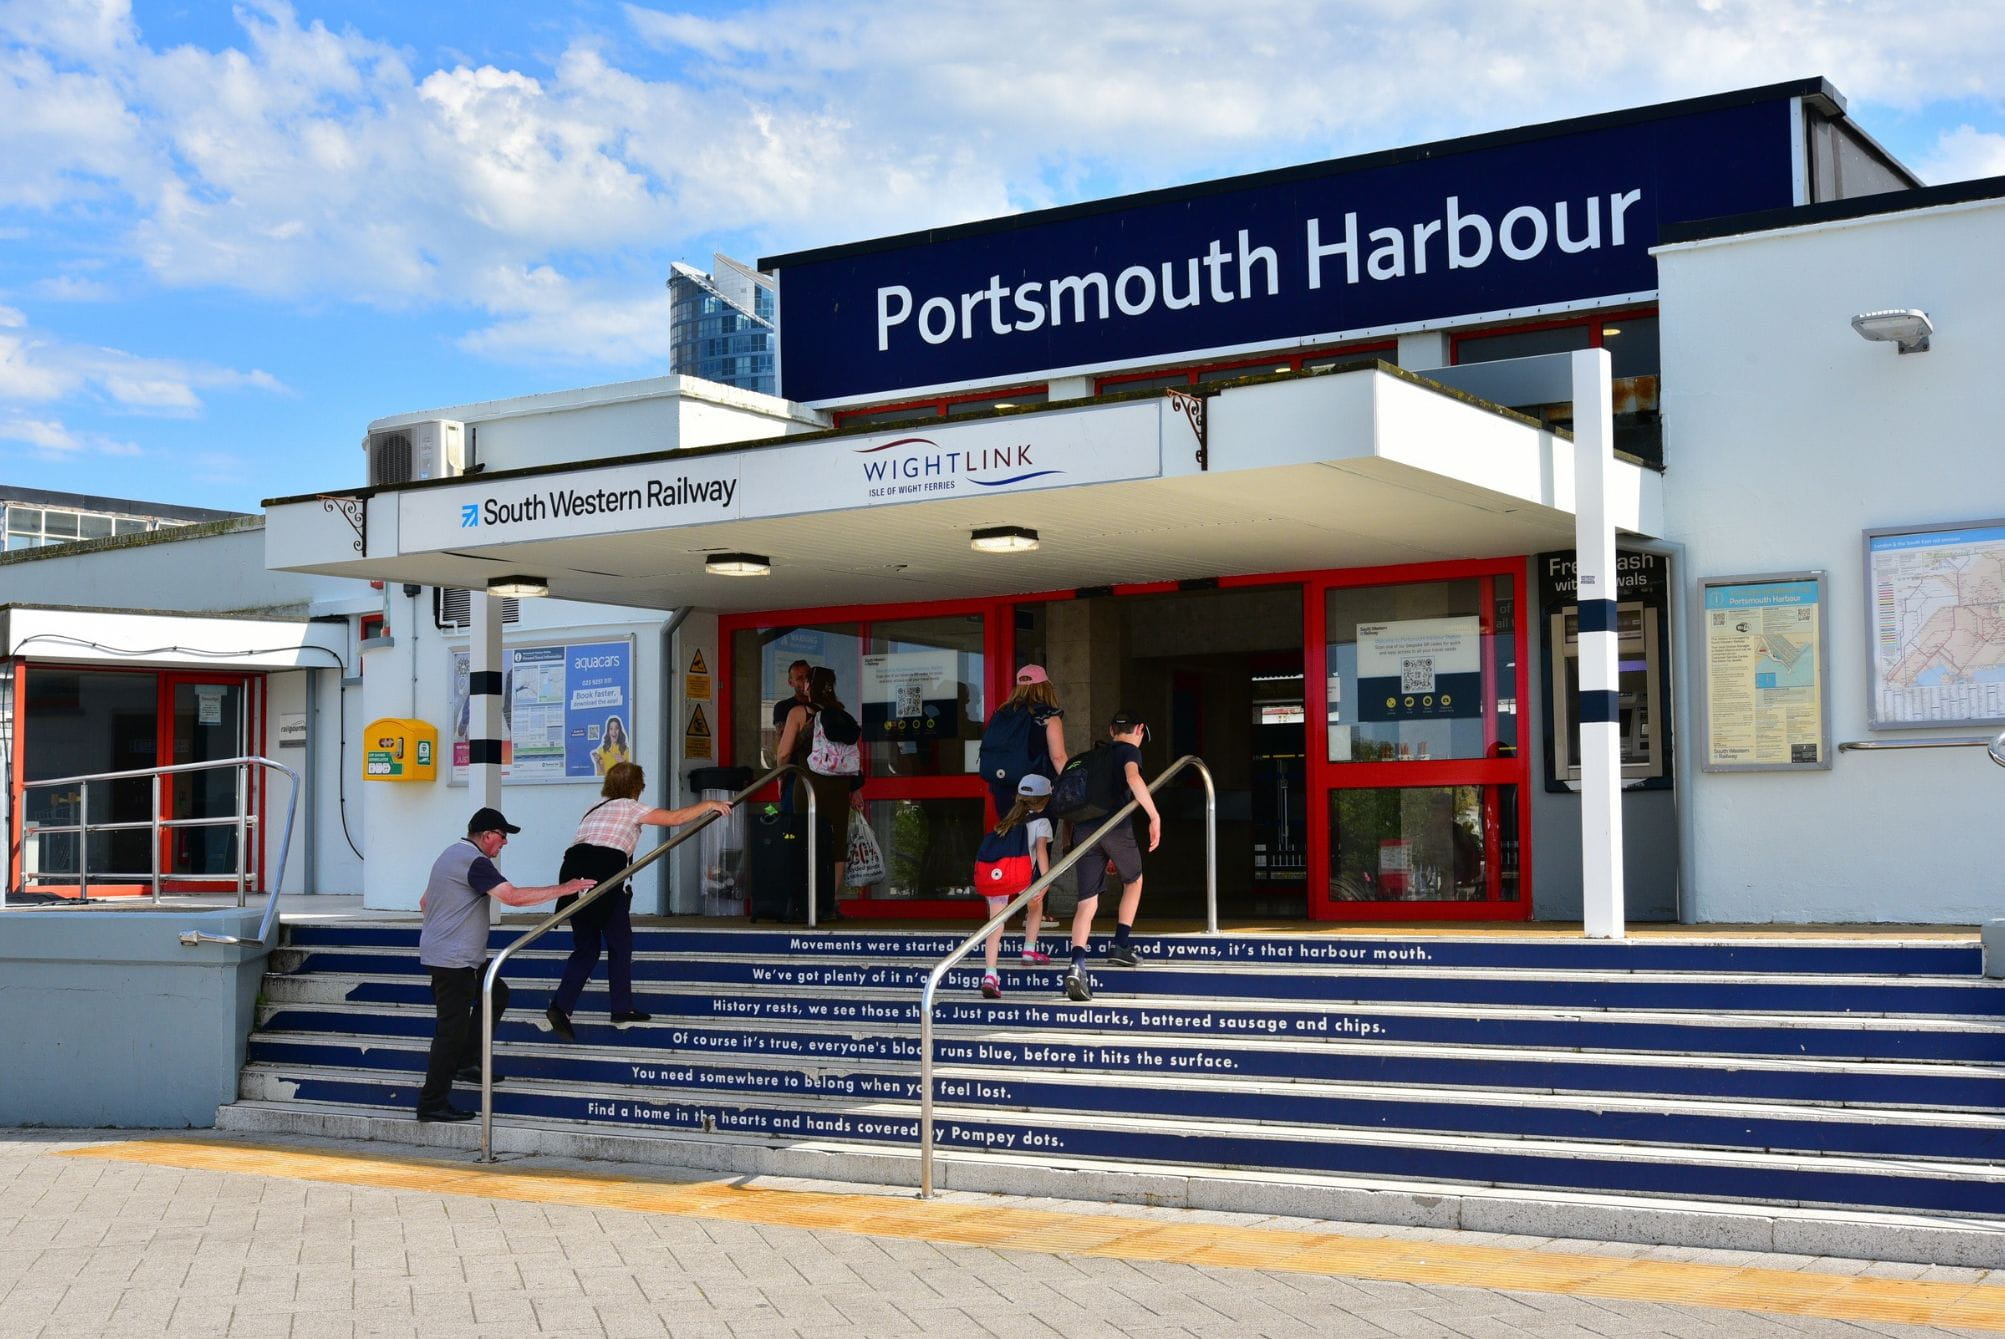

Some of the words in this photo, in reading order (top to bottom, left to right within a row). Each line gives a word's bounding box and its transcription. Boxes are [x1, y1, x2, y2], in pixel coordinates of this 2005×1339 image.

[876, 229, 1280, 351] Portsmouth
[1307, 188, 1642, 290] Harbour
[863, 444, 1033, 482] WIGHTLINK
[483, 493, 546, 526] South
[549, 488, 642, 518] Western
[647, 477, 737, 510] Railway
[869, 486, 885, 497] ISLE
[887, 486, 897, 496] OF
[899, 483, 922, 494] WIGHT
[924, 480, 956, 491] FERRIES
[1549, 557, 1577, 576] Fre
[1616, 552, 1654, 570] ash
[1555, 571, 1648, 592] witwals
[574, 655, 620, 672] aquacars
[790, 938, 862, 951] Movements
[867, 942, 900, 951] were
[905, 939, 954, 951] started
[998, 940, 1023, 952] this
[1035, 940, 1058, 956] ity,
[1065, 939, 1092, 953] lie
[1133, 941, 1161, 954] ood
[1167, 945, 1222, 958] yawns,
[1229, 943, 1254, 956] it's
[1260, 943, 1293, 957] that
[1300, 944, 1367, 959] harbour
[1373, 946, 1432, 960] mouth.
[752, 968, 792, 981] We've
[797, 971, 819, 984] got
[824, 969, 866, 985] plenty
[871, 970, 886, 983] of
[891, 971, 901, 983] it
[1007, 973, 1020, 986] in
[1026, 973, 1049, 986] the
[713, 1000, 761, 1015] History
[766, 1003, 802, 1016] rests,
[808, 1006, 828, 1015] we
[833, 1006, 856, 1016] see
[861, 1004, 899, 1017] those
[952, 1006, 982, 1019] Just
[987, 1008, 1020, 1022] past
[1025, 1008, 1050, 1022] the
[1055, 1010, 1134, 1027] mudlarks,
[1141, 1012, 1212, 1028] battered
[1218, 1018, 1288, 1032] sausage
[1295, 1017, 1328, 1031] and
[1334, 1018, 1387, 1037] chips.
[672, 1032, 688, 1044] Of
[693, 1036, 738, 1047] course
[743, 1035, 765, 1048] it's
[770, 1038, 803, 1051] true,
[808, 1038, 887, 1055] everyone's
[892, 1041, 934, 1057] bloo
[940, 1047, 973, 1058] runs
[979, 1045, 1017, 1062] blue,
[1024, 1046, 1077, 1062] before
[1083, 1049, 1095, 1063] it
[1101, 1049, 1131, 1065] hits
[1136, 1050, 1163, 1066] the
[1169, 1053, 1239, 1069] surface.
[631, 1066, 656, 1079] You
[661, 1069, 693, 1081] need
[700, 1073, 779, 1087] somewhere
[784, 1075, 799, 1087] to
[805, 1076, 854, 1093] belong
[861, 1078, 901, 1093] when
[906, 1083, 934, 1097] yo
[940, 1080, 970, 1096] feel
[977, 1083, 1012, 1099] lost.
[588, 1102, 615, 1116] Find
[620, 1107, 629, 1117] a
[634, 1105, 671, 1120] home
[676, 1107, 689, 1121] in
[694, 1110, 716, 1125] the
[721, 1111, 767, 1127] hearts
[773, 1114, 800, 1129] and
[806, 1116, 851, 1132] hands
[857, 1121, 919, 1137] covered
[931, 1127, 945, 1142] y
[951, 1126, 1016, 1148] Pompey
[1022, 1130, 1065, 1148] dots.
